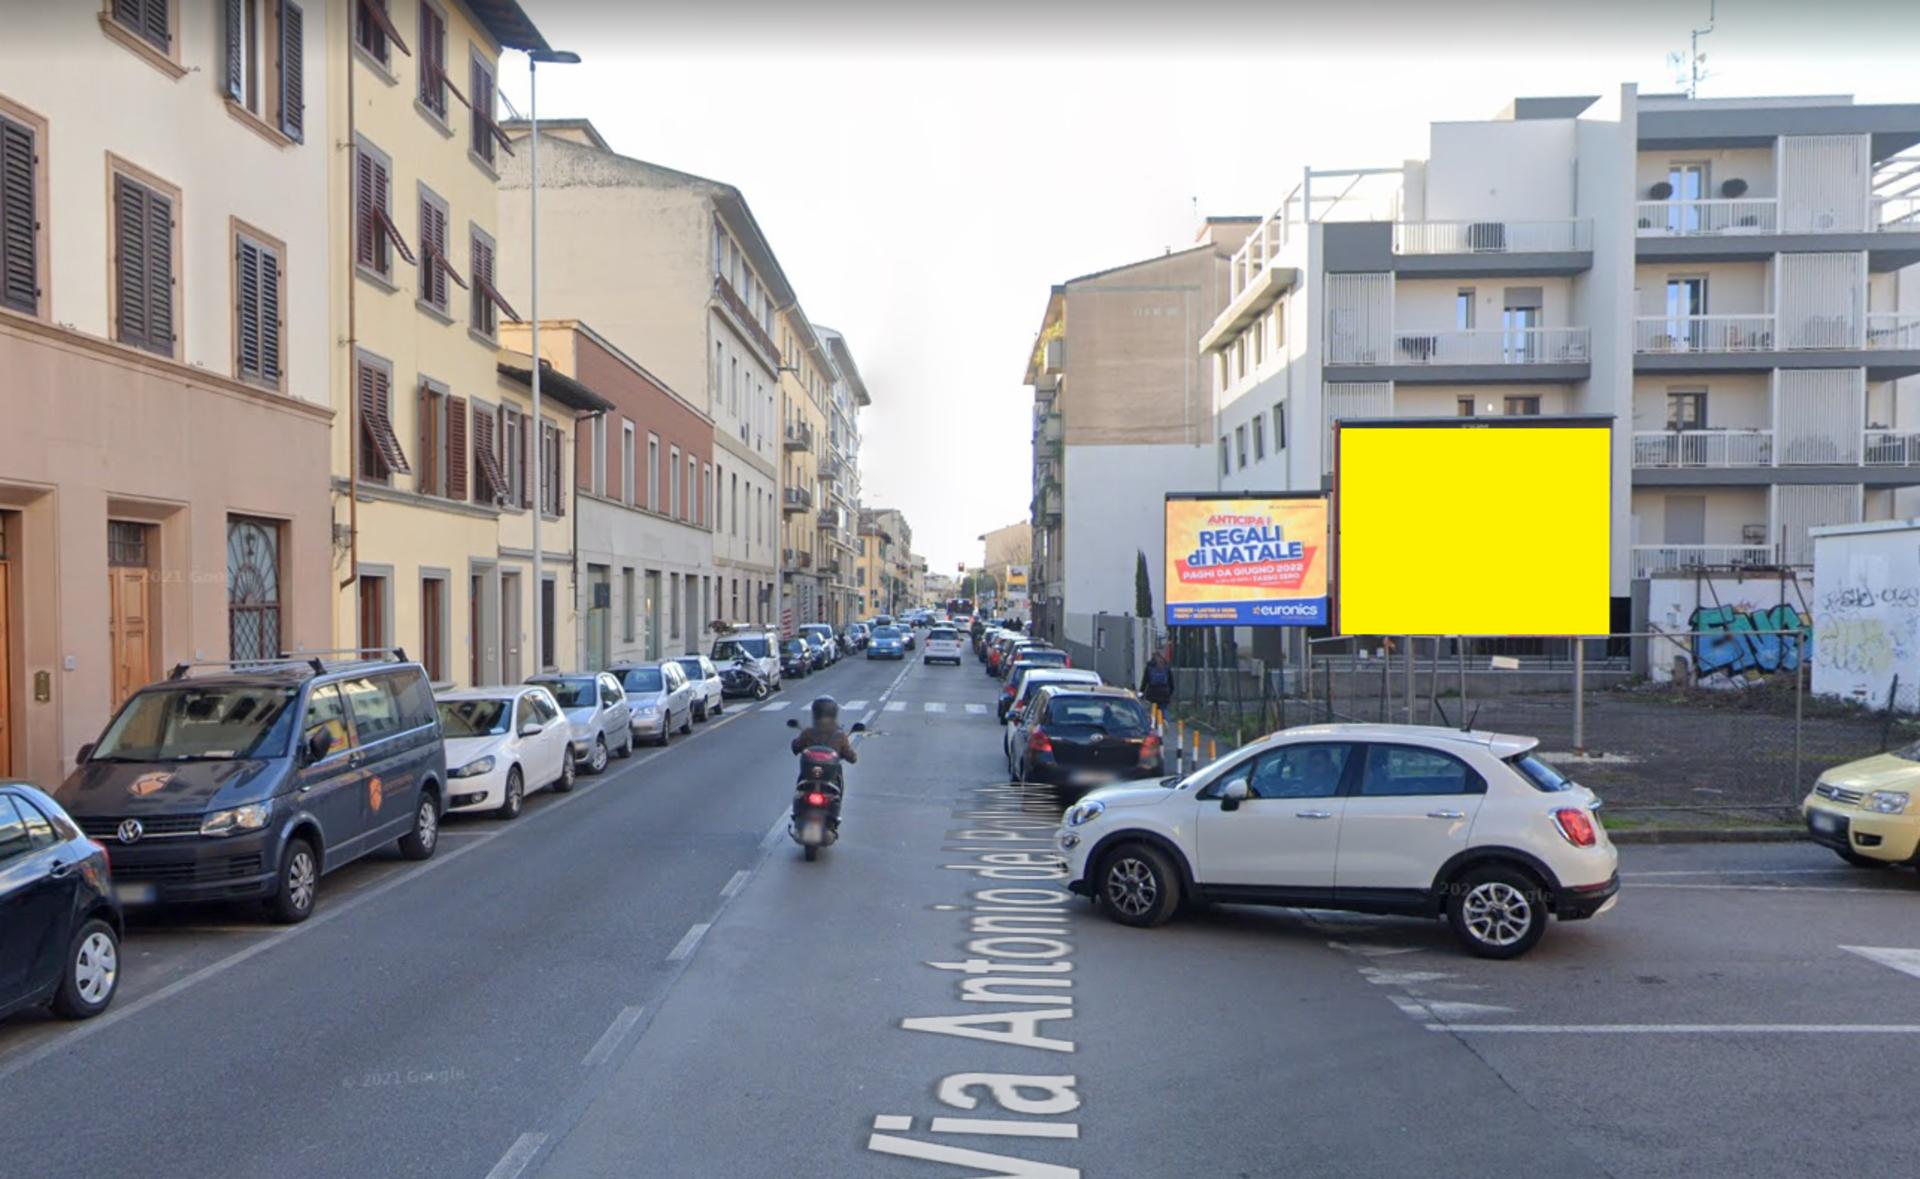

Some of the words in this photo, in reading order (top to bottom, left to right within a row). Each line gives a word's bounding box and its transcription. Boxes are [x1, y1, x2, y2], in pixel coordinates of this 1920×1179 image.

[1207, 514, 1265, 526] ANTICIPA
[1199, 525, 1282, 547] REGALI
[1187, 550, 1207, 567] di
[1211, 542, 1303, 565] NATALE
[1183, 568, 1216, 581] PAGHI
[1216, 568, 1232, 578] DA
[1233, 564, 1275, 577] GIUGNO
[1260, 603, 1318, 616] euronics
